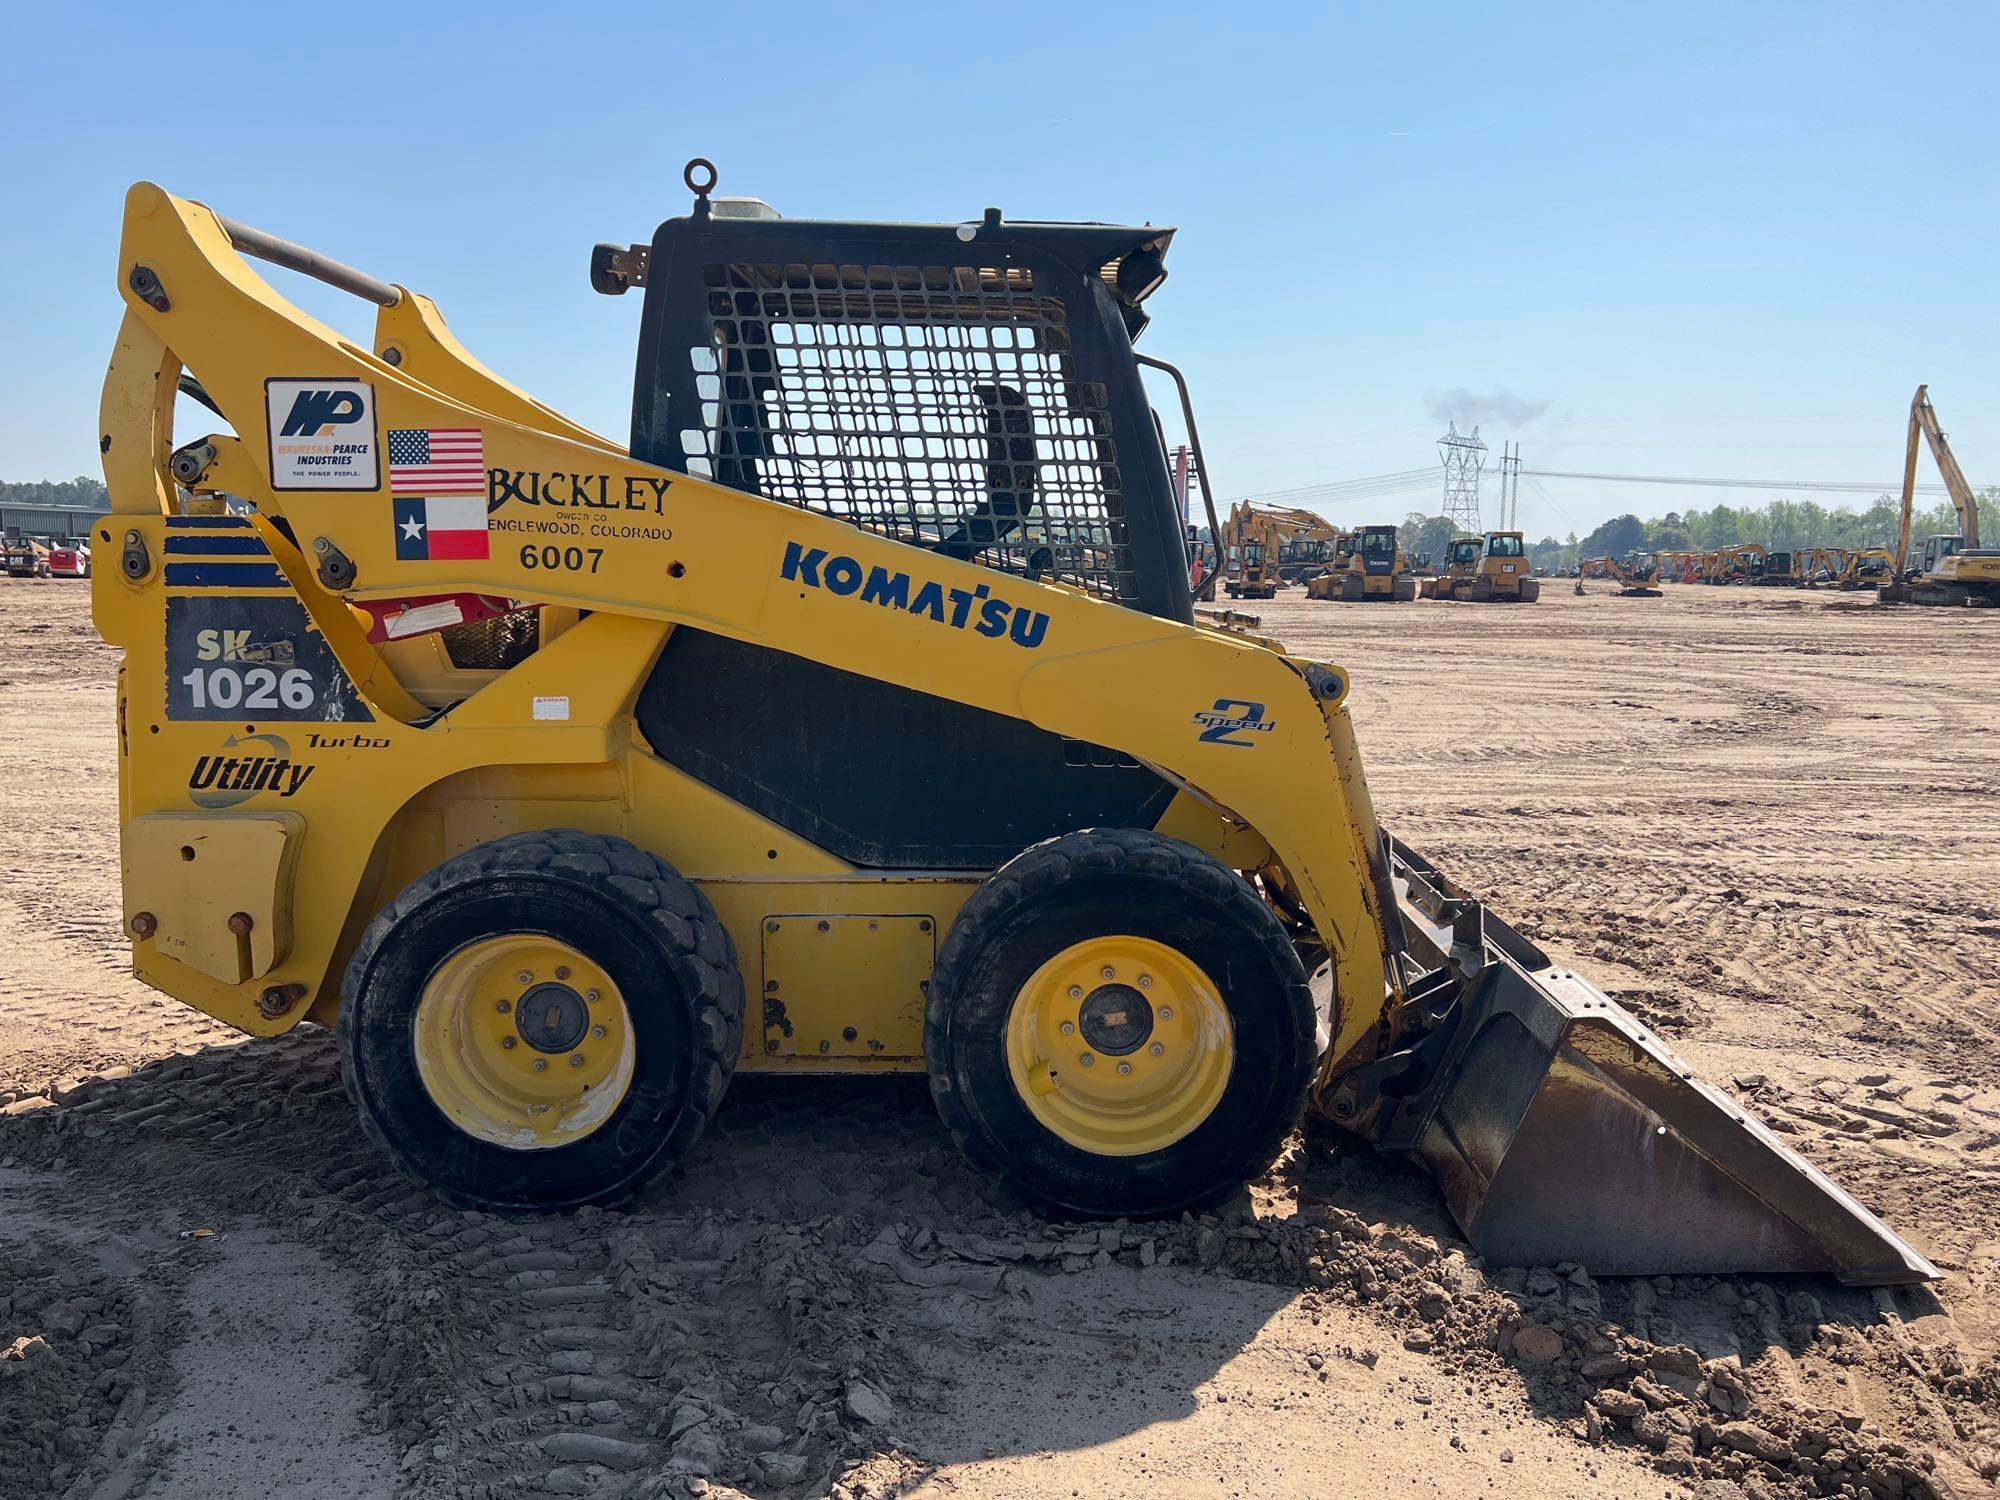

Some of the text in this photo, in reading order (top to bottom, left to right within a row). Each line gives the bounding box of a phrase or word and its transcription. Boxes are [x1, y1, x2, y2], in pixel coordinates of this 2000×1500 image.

[297, 456, 352, 465] INDUSTRIES
[486, 468, 674, 516] BUCKLEY
[487, 519, 673, 541] ENGLEWOOD, COLORADO
[10, 556, 24, 566] CAT
[520, 544, 604, 574] 6007
[1502, 564, 1514, 572] CAT
[780, 540, 1051, 649] KOMATSU
[196, 629, 253, 661] SK
[182, 667, 315, 710] 1026
[1191, 698, 1276, 747] 2 Speed
[305, 733, 391, 748] Turbo
[189, 755, 316, 797] Utility
